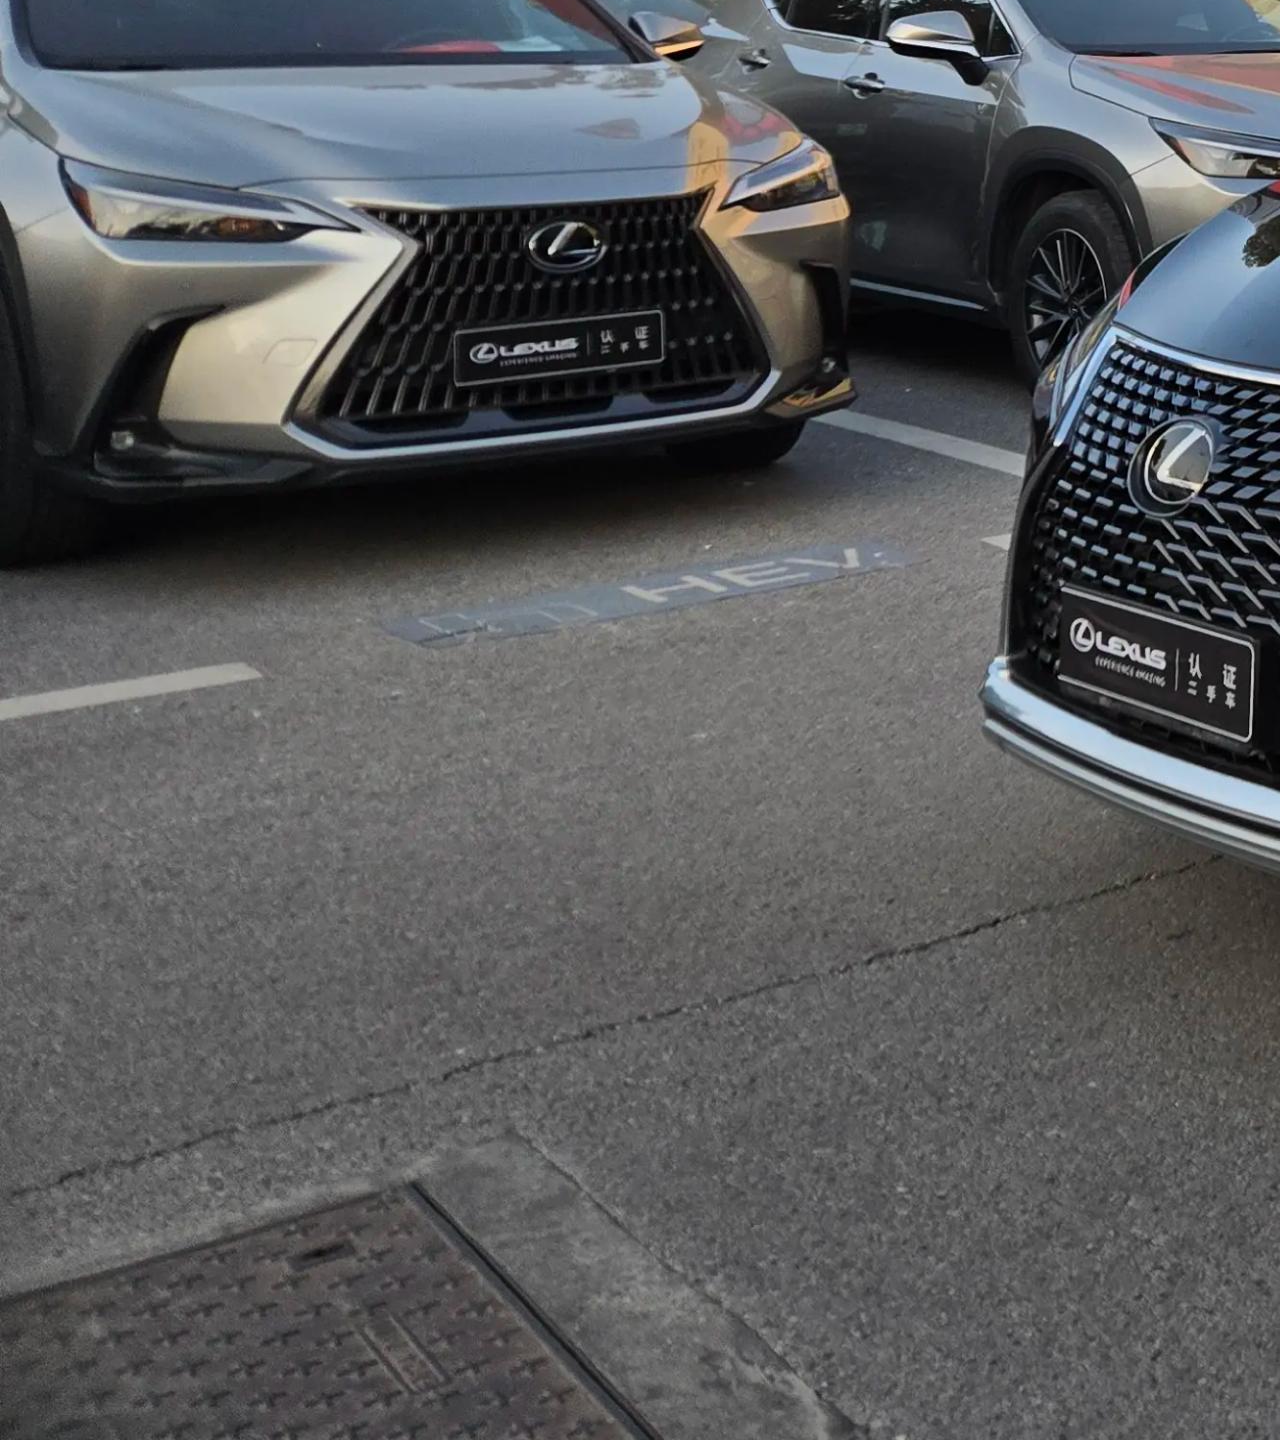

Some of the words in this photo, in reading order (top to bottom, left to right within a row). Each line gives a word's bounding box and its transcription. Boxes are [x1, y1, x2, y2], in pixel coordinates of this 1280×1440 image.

[499, 337, 580, 358] LEXUS
[620, 546, 860, 603] HEV
[1096, 630, 1167, 671] LEXUS
